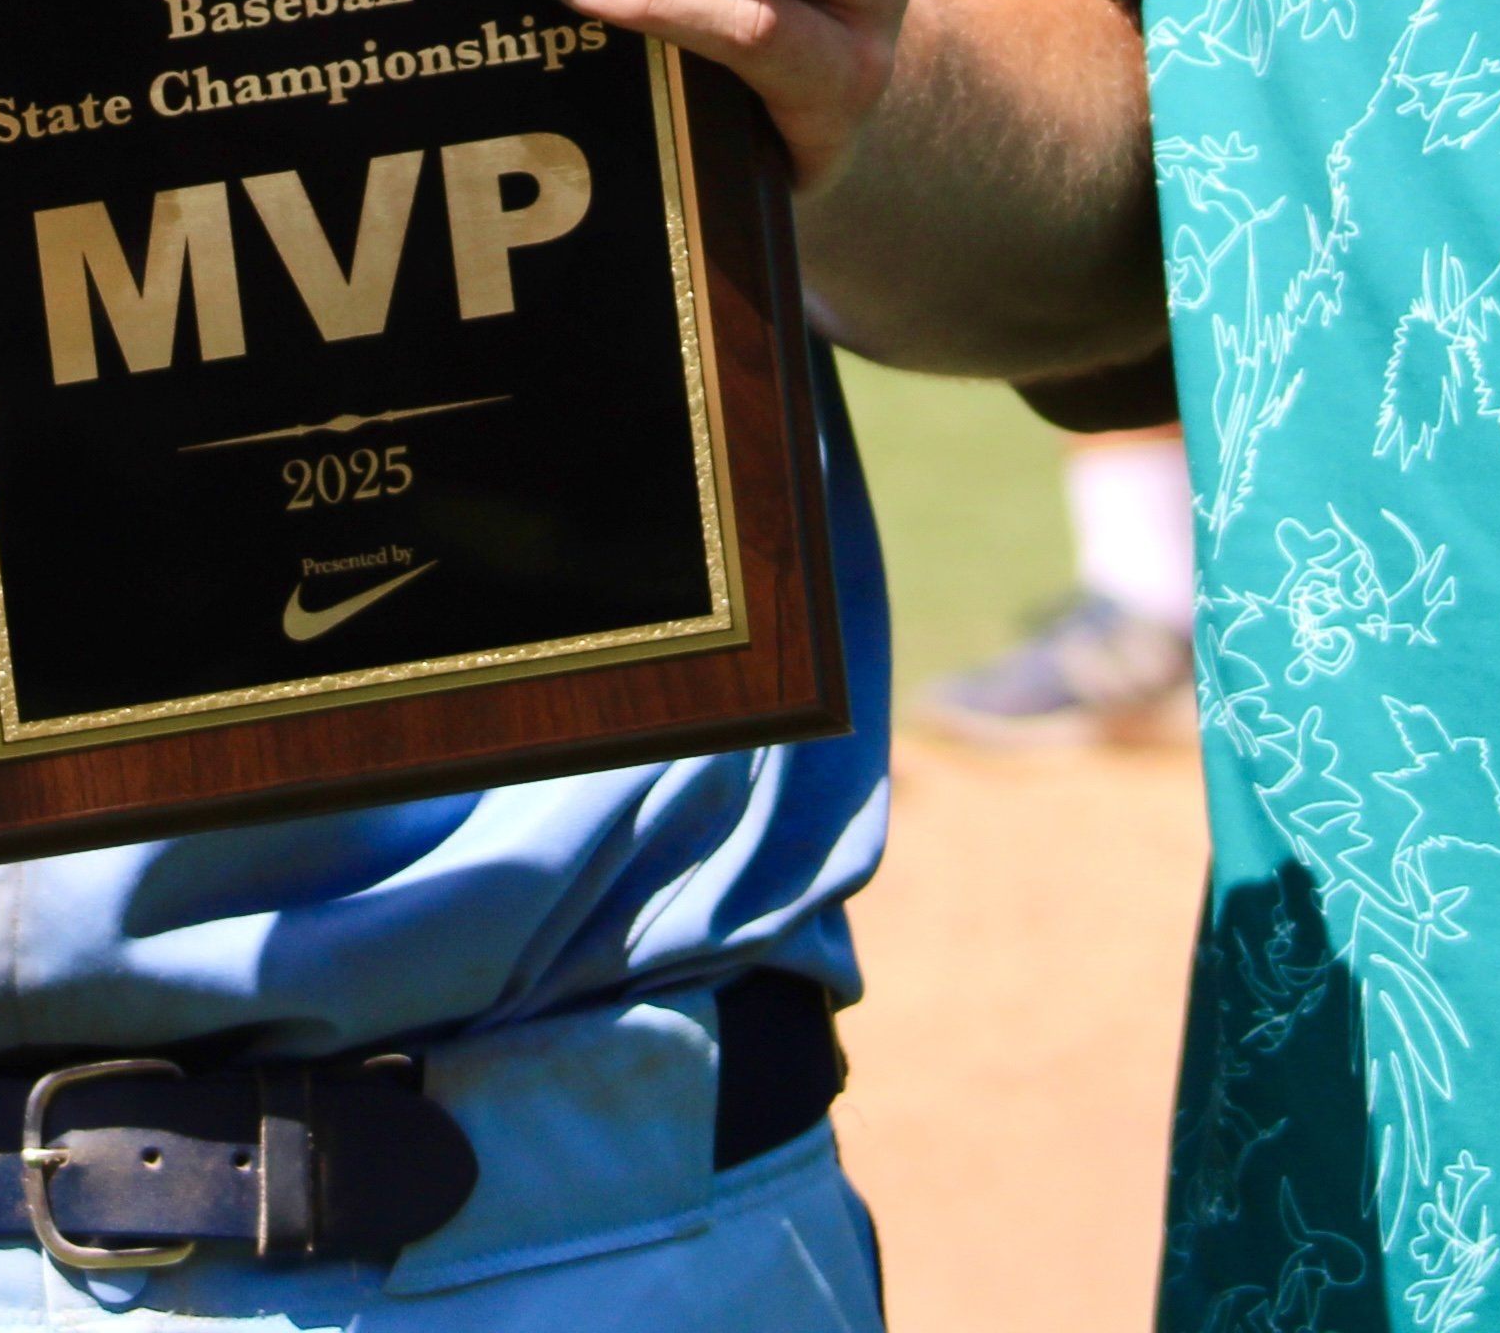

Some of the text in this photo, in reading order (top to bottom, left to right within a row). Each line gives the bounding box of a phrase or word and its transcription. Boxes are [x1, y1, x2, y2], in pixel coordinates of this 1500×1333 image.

[150, 16, 608, 117] Championships
[34, 132, 593, 386] MVP
[283, 445, 413, 511] 2025
[302, 544, 413, 576] Presented by
